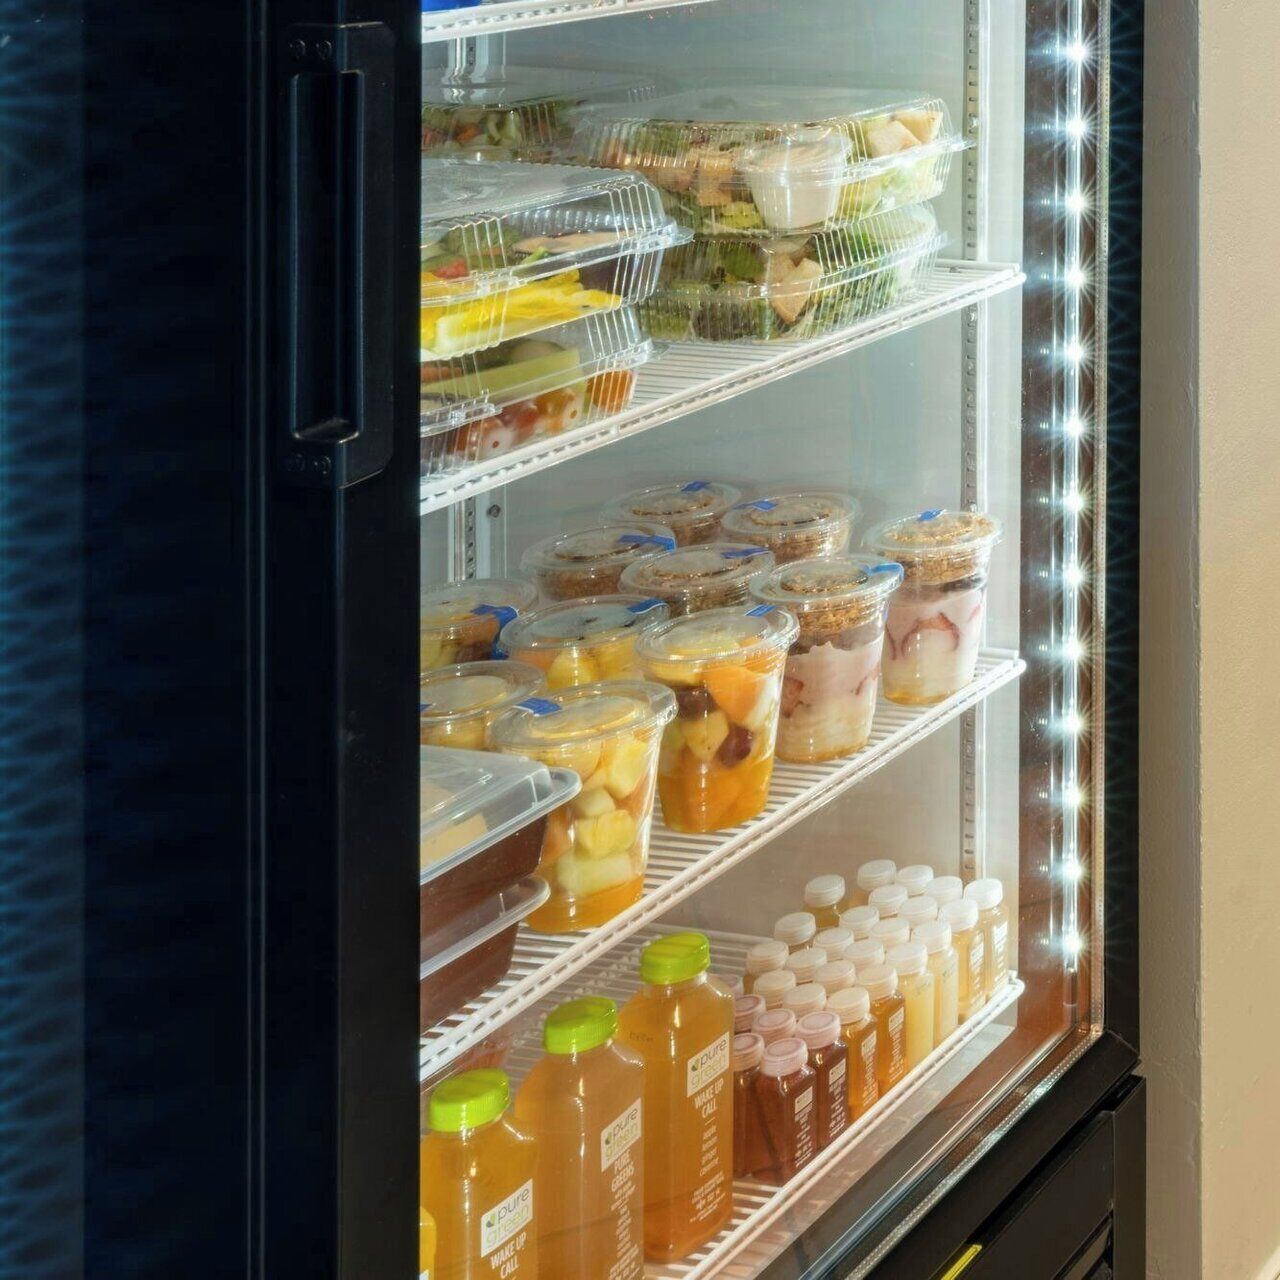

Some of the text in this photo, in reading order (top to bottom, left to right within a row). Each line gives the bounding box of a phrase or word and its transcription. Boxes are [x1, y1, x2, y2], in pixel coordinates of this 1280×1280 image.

[700, 1039, 727, 1071] pure
[612, 1107, 638, 1139] pure
[497, 1187, 531, 1224] pure
[490, 1231, 527, 1270] WAKE UP
[500, 1255, 520, 1280] CALL
